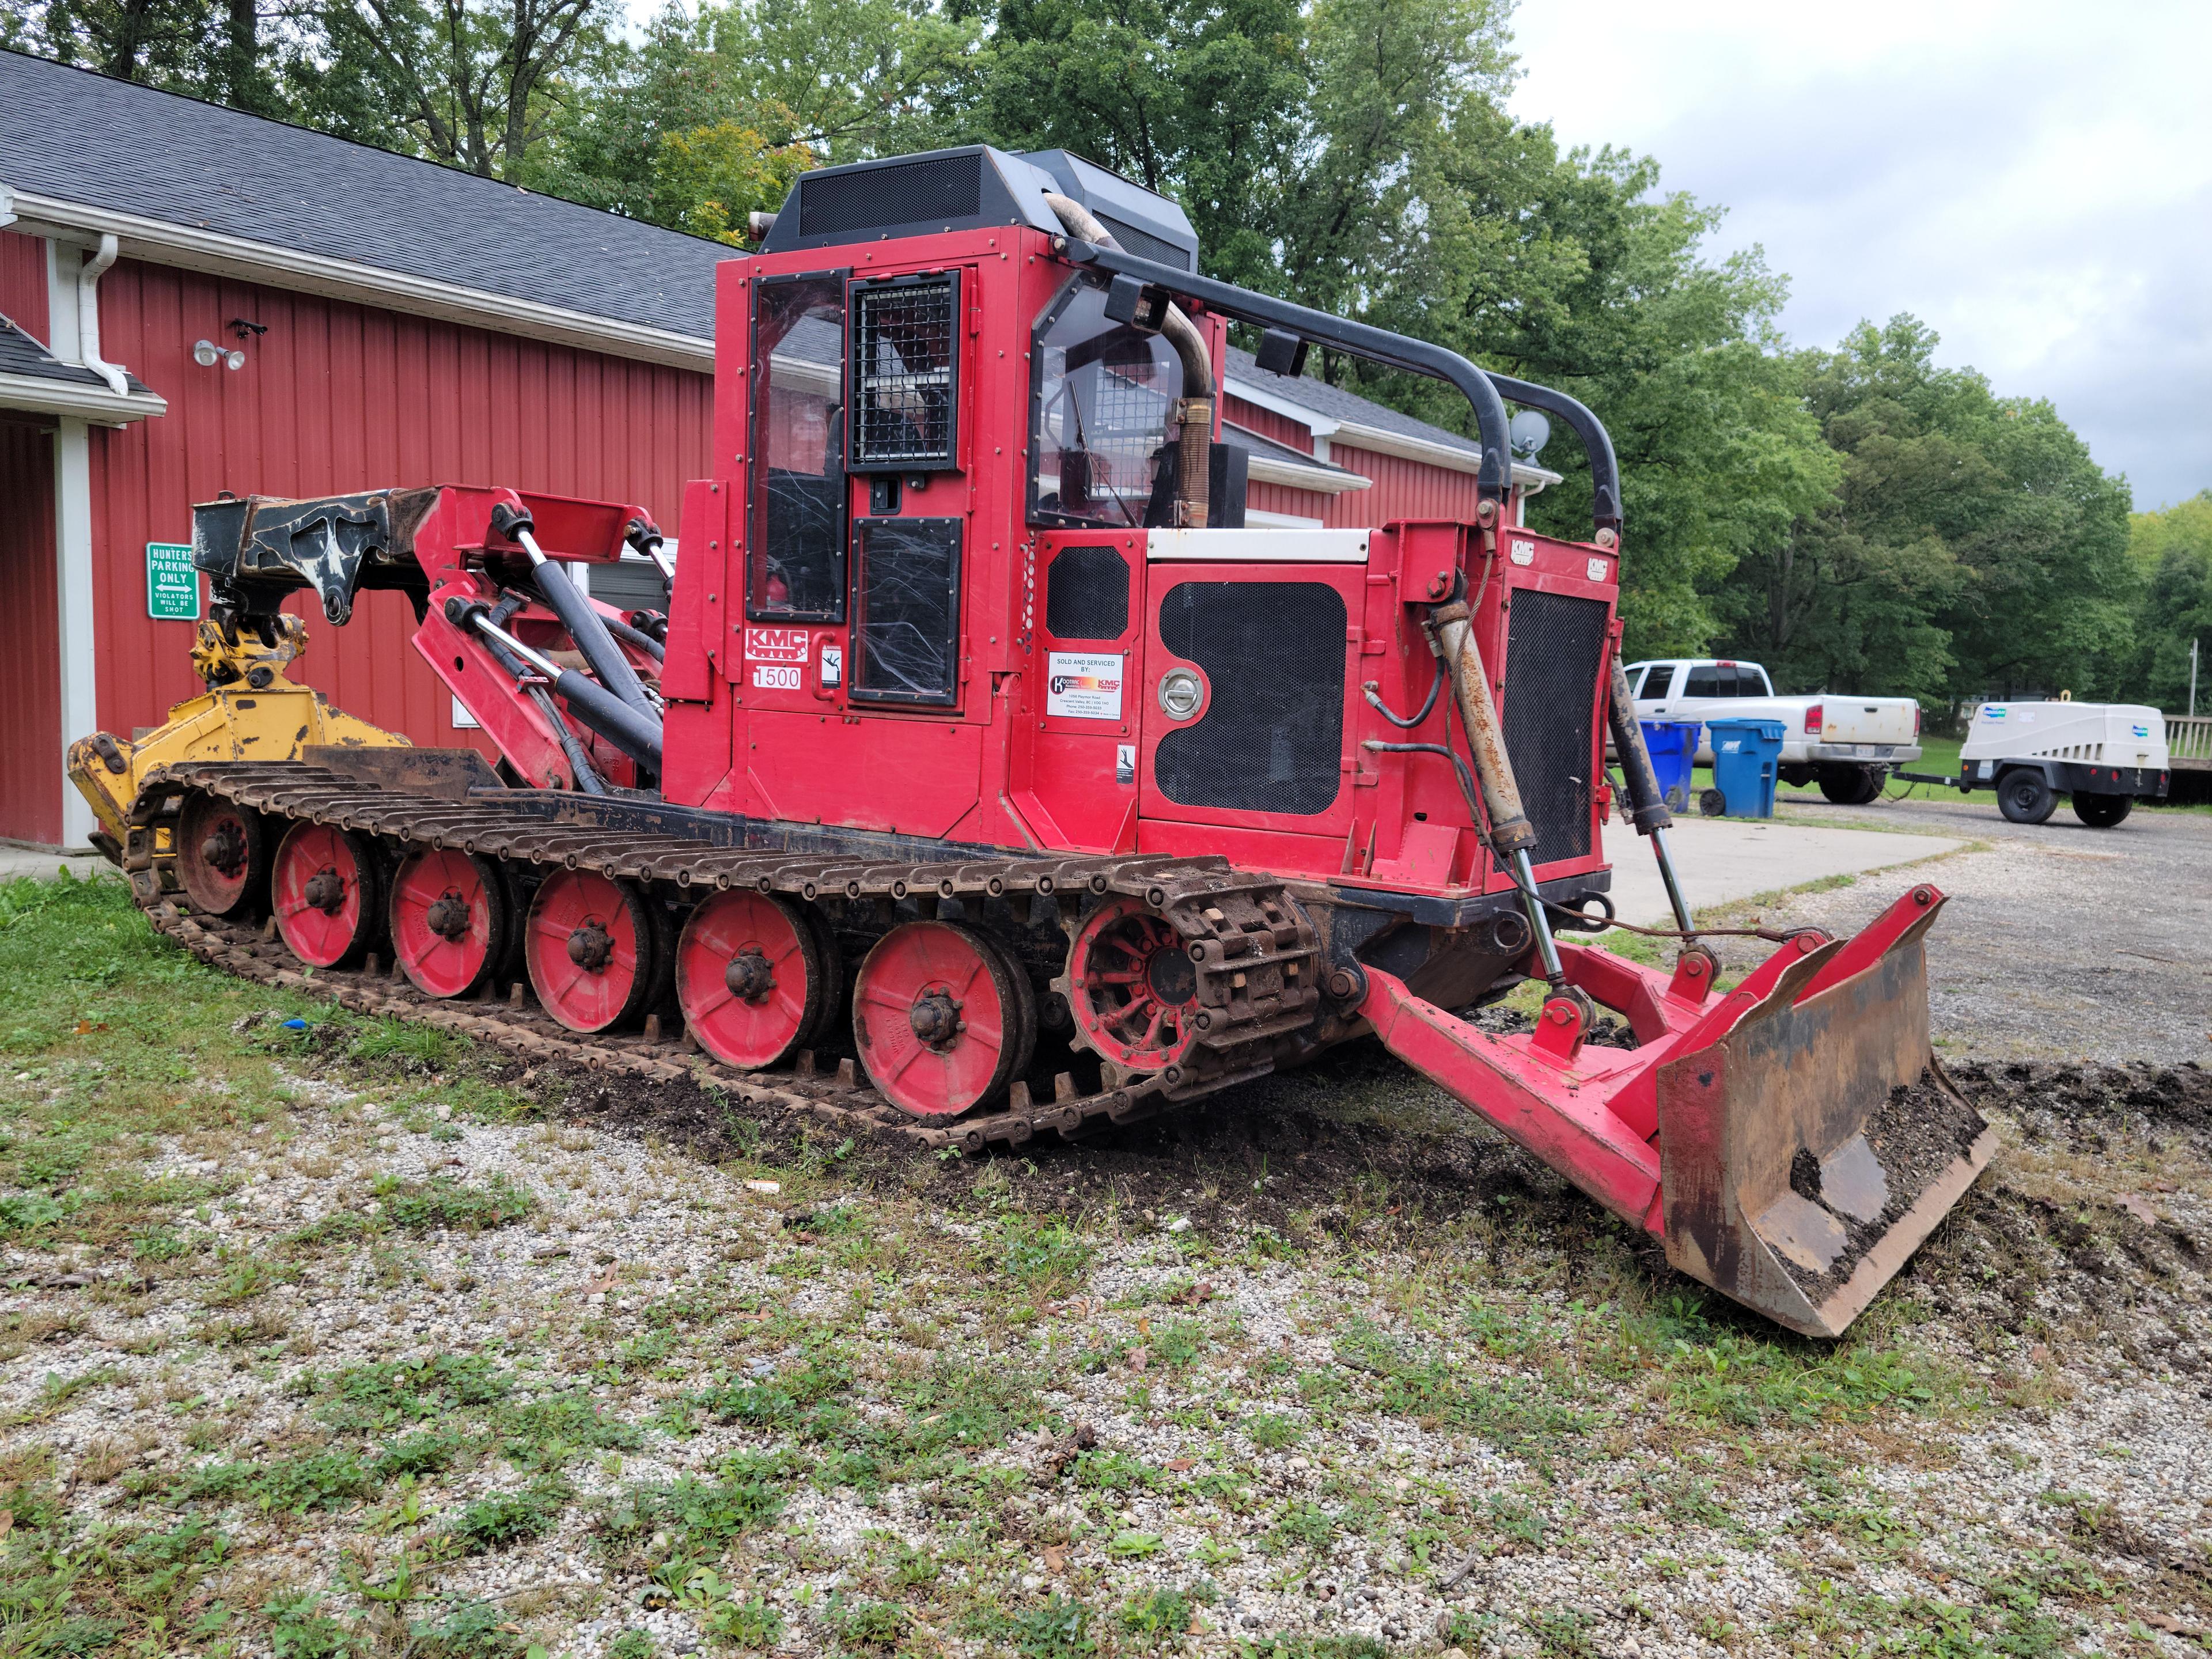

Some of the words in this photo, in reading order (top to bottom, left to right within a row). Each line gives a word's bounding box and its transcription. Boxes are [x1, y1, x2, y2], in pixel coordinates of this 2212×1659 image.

[153, 549, 192, 560] HUNTERS
[1511, 539, 1535, 555] KMC
[151, 560, 195, 573] PARKING
[1588, 557, 1608, 573] KMC
[160, 573, 187, 584] ONLY
[748, 630, 806, 647] KMC
[757, 668, 799, 687] 1500
